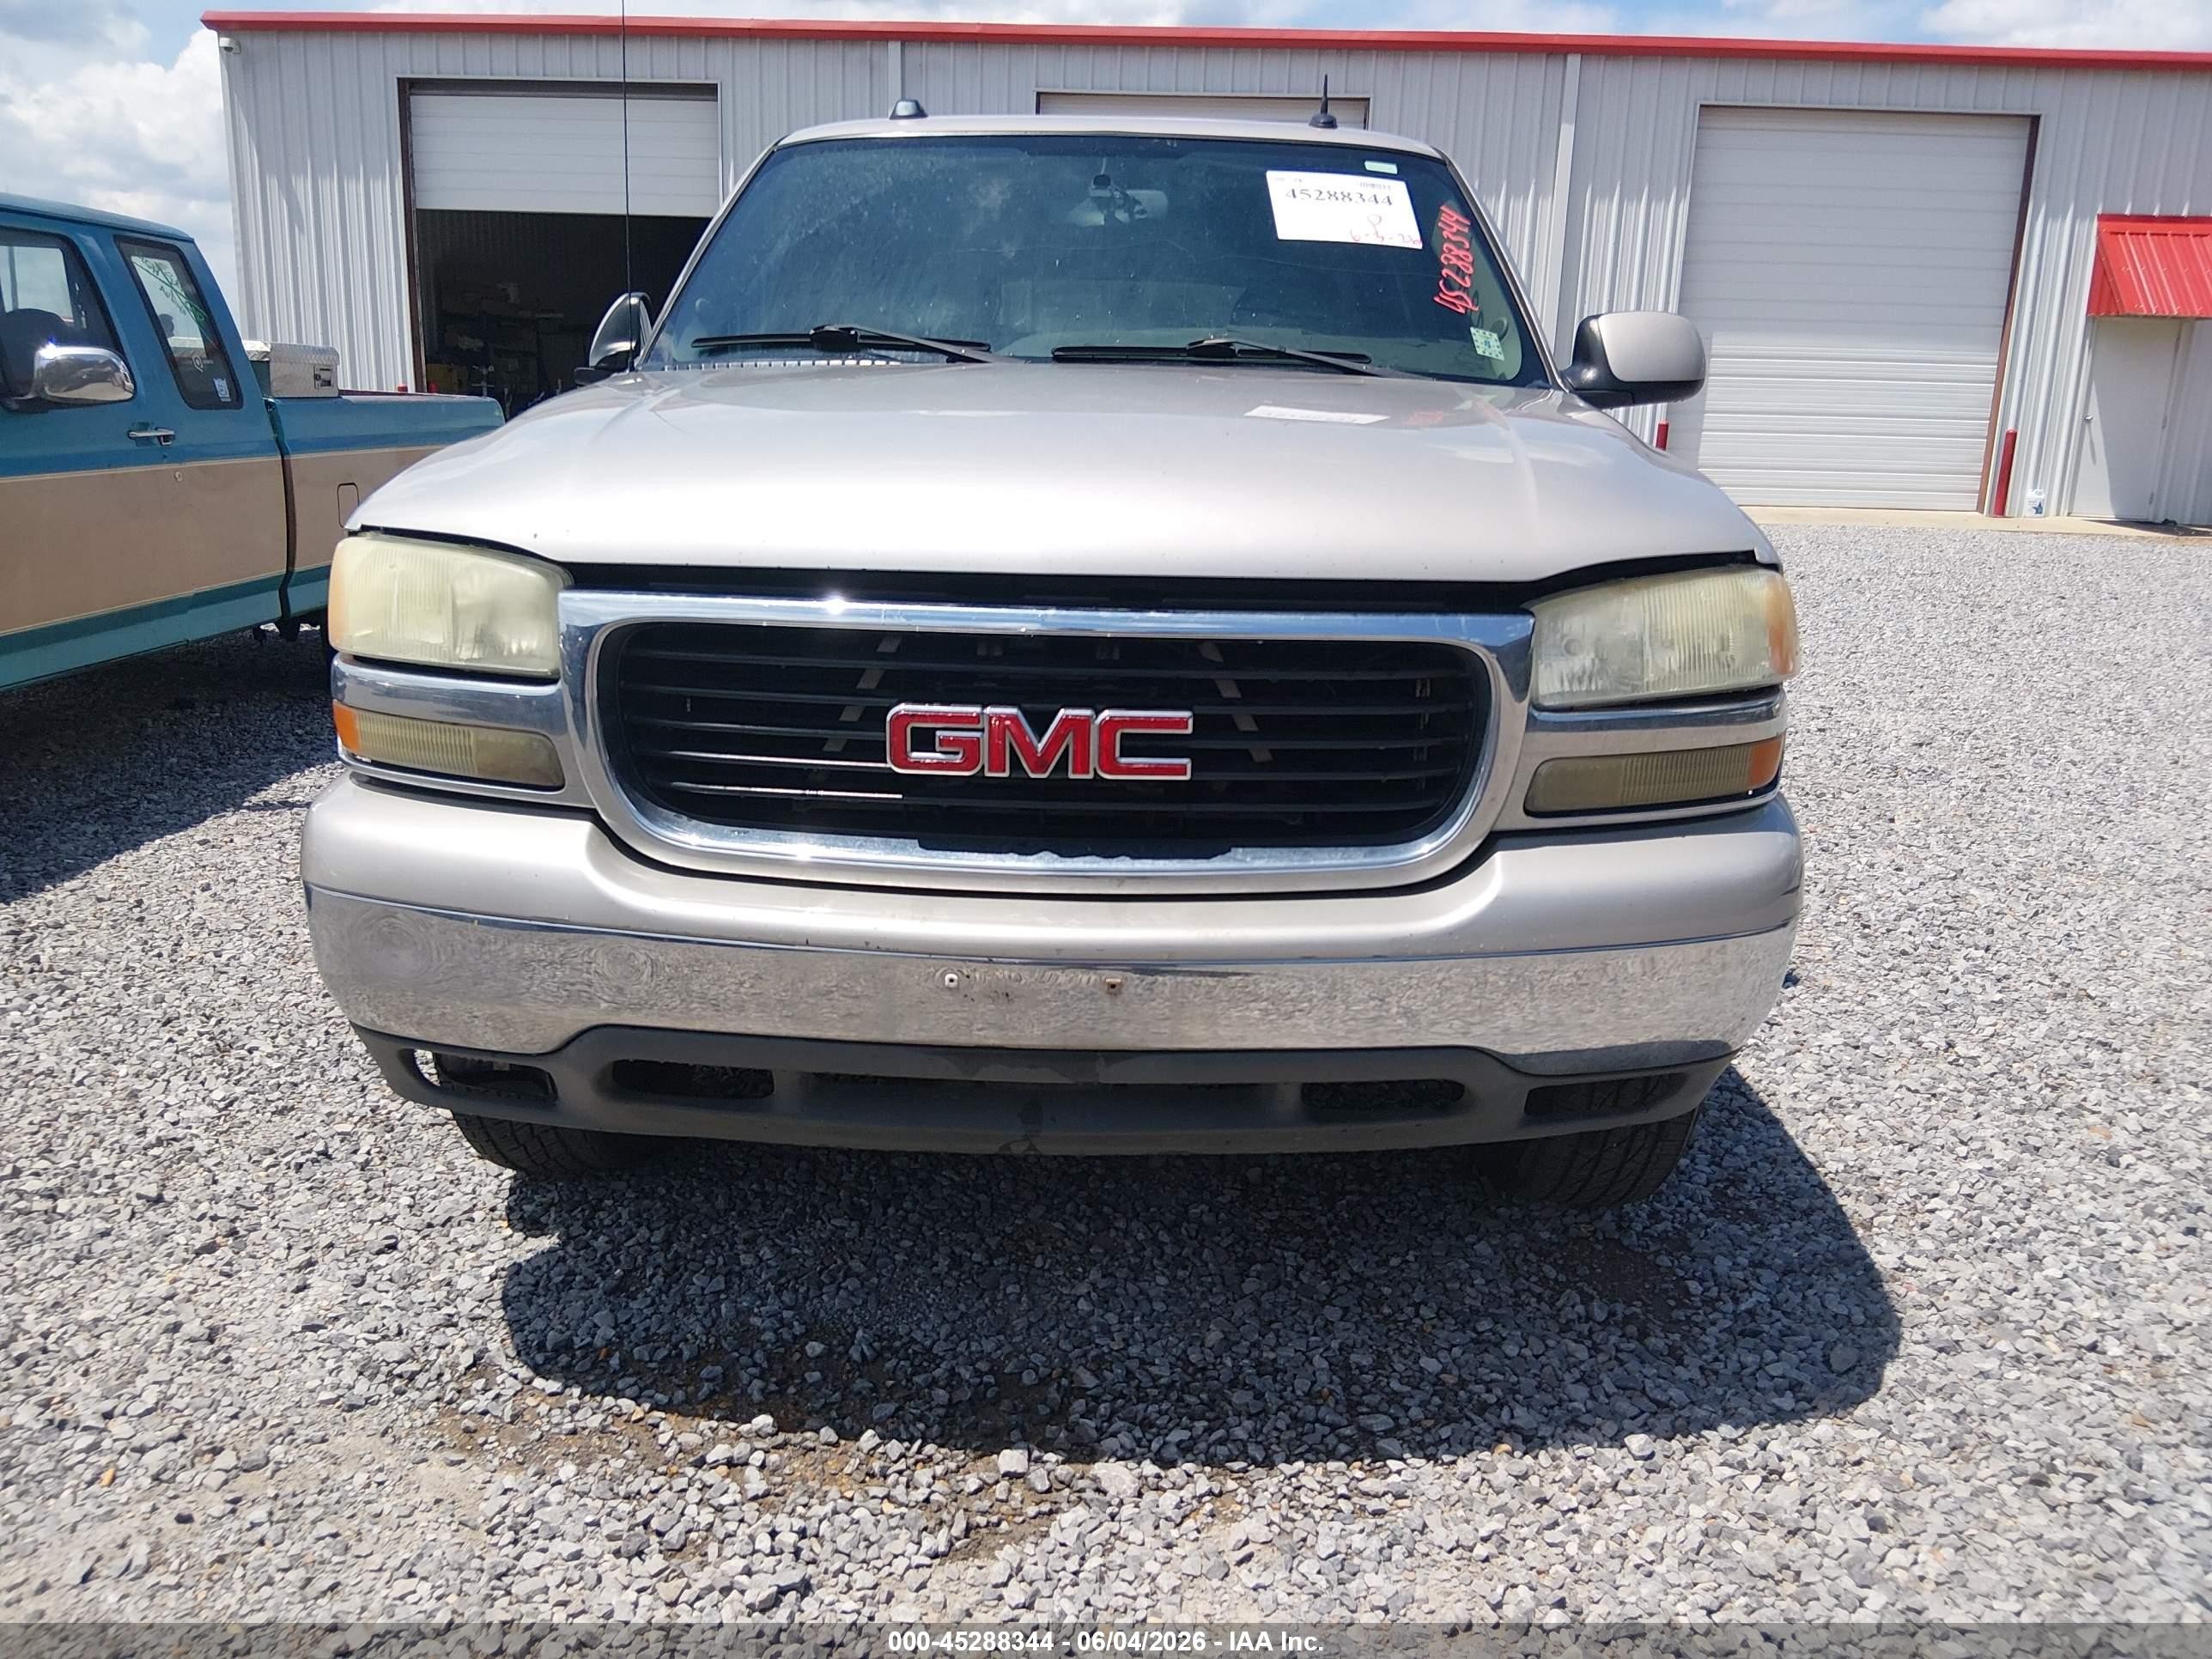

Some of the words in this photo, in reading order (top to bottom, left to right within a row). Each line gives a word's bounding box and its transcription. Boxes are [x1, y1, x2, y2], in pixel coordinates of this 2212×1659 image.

[1285, 188, 1394, 207] 45288344
[1433, 204, 1479, 314] 45288344
[886, 702, 1194, 781] GMC
